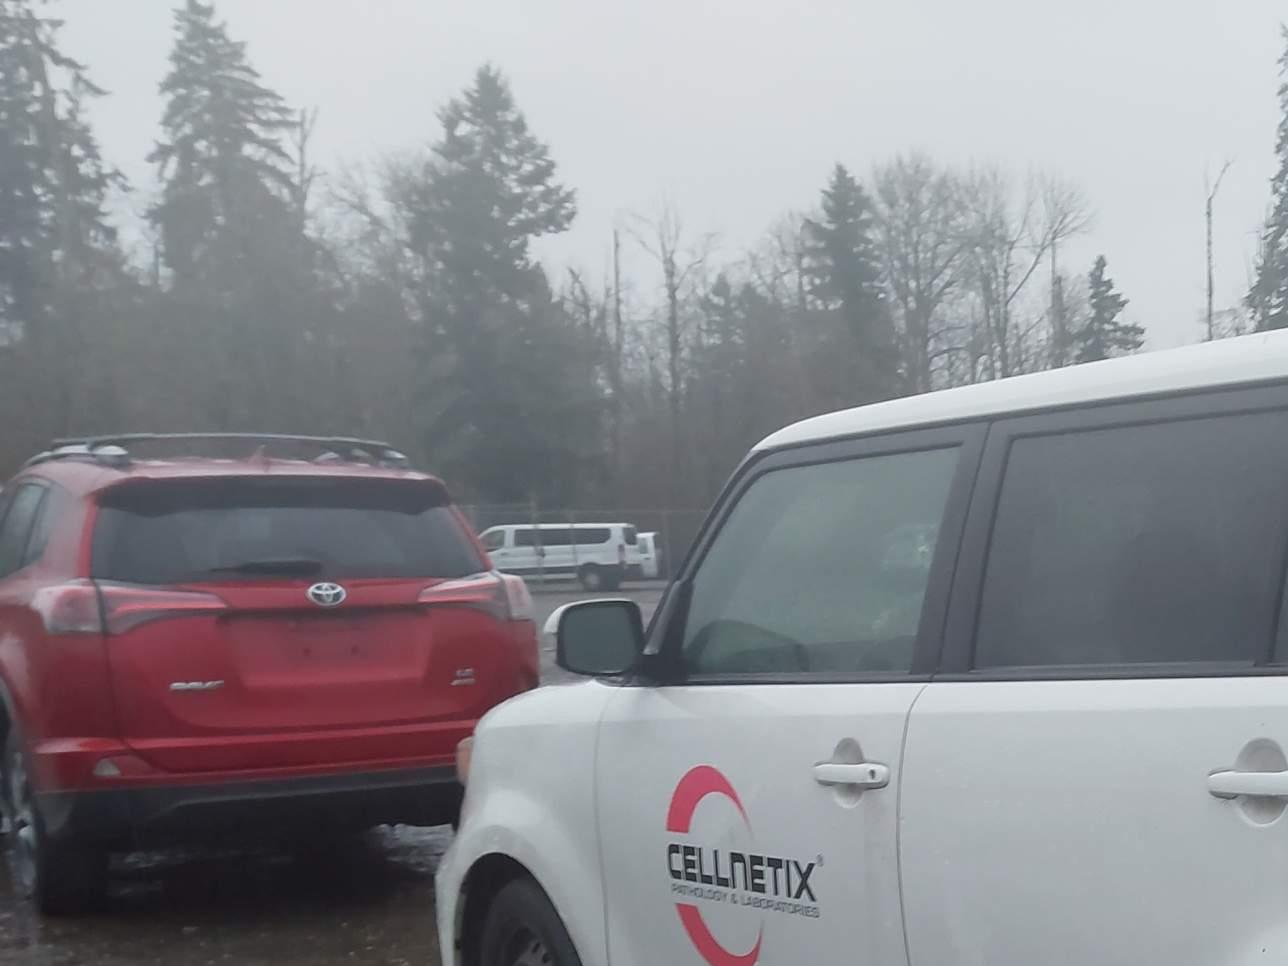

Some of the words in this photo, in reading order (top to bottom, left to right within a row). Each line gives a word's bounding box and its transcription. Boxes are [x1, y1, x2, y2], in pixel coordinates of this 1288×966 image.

[671, 883, 728, 903] PATHOLOGY
[730, 893, 738, 905] &
[740, 896, 820, 919] LABORATORIES
